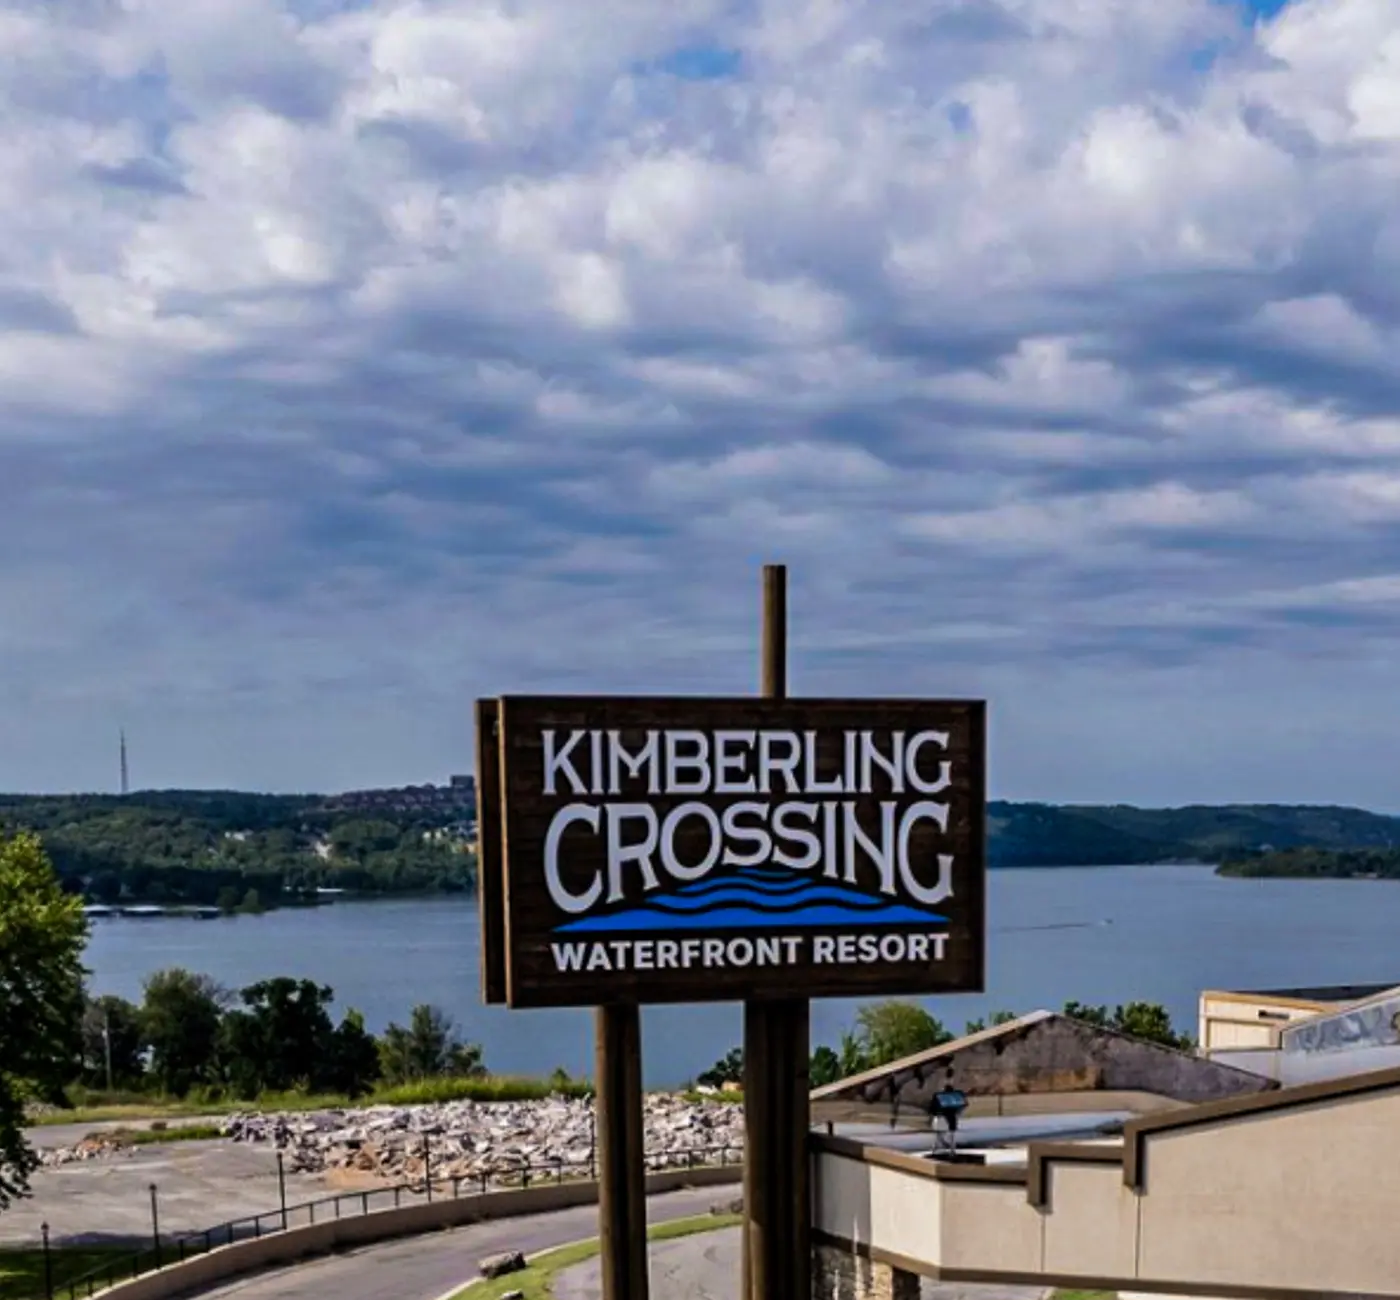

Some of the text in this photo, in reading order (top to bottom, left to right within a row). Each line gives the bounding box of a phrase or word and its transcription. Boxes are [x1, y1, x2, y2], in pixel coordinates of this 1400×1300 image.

[541, 729, 953, 796] KIMBERLING
[543, 800, 955, 914] CROSSING
[550, 931, 951, 972] WATERFRONT RESORT
